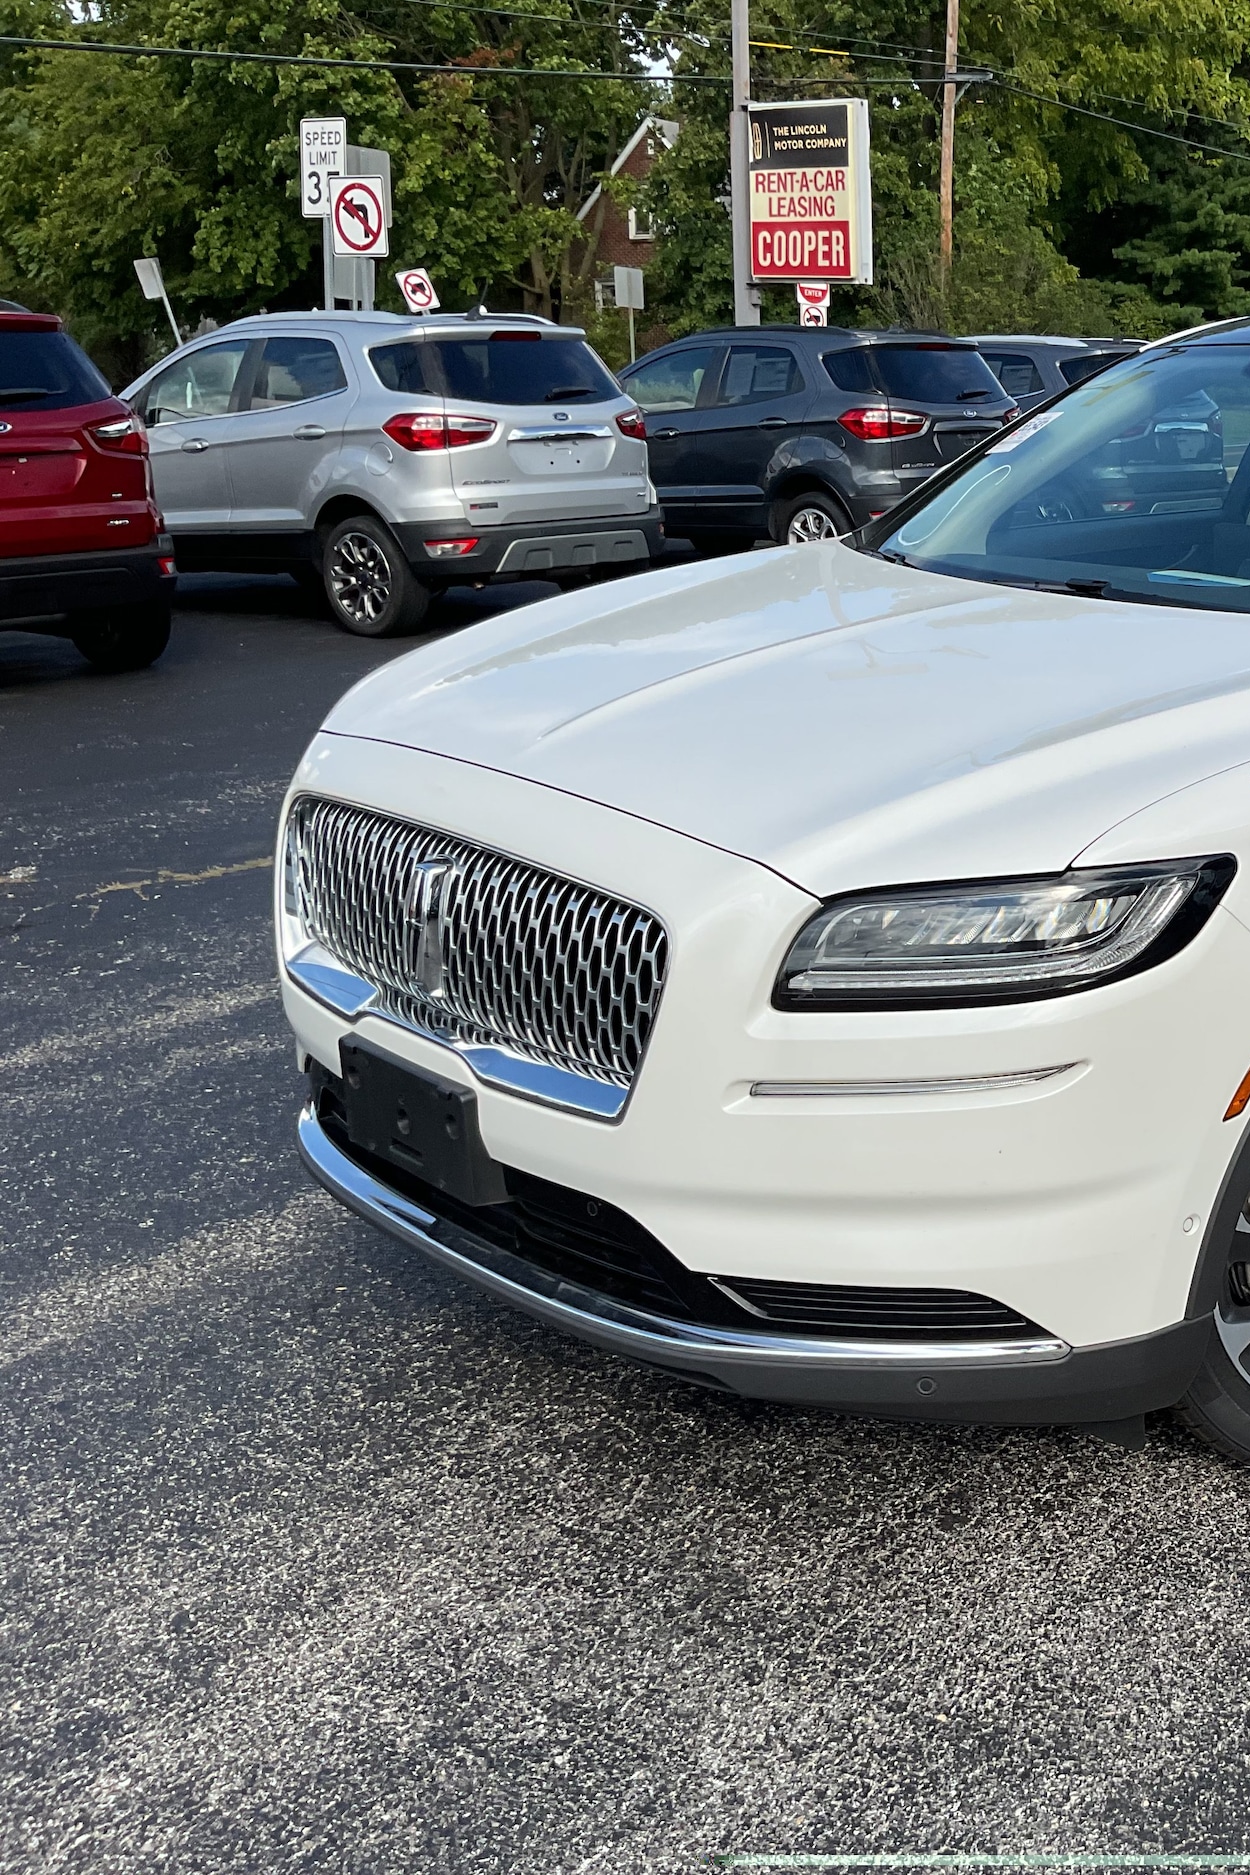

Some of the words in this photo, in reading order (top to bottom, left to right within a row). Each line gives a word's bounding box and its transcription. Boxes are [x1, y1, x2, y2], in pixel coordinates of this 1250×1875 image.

[772, 126, 789, 137] THE
[790, 124, 827, 136] LINCOLN
[305, 131, 342, 146] SPEED
[774, 140, 804, 151] MOTOR
[805, 138, 847, 149] COMPANY
[309, 151, 338, 166] LIMIT
[307, 171, 340, 205] 3
[755, 169, 846, 194] RENT-A-CAR
[768, 195, 836, 218] LEASING
[757, 230, 845, 267] COOPER
[804, 288, 823, 298] ENTER
